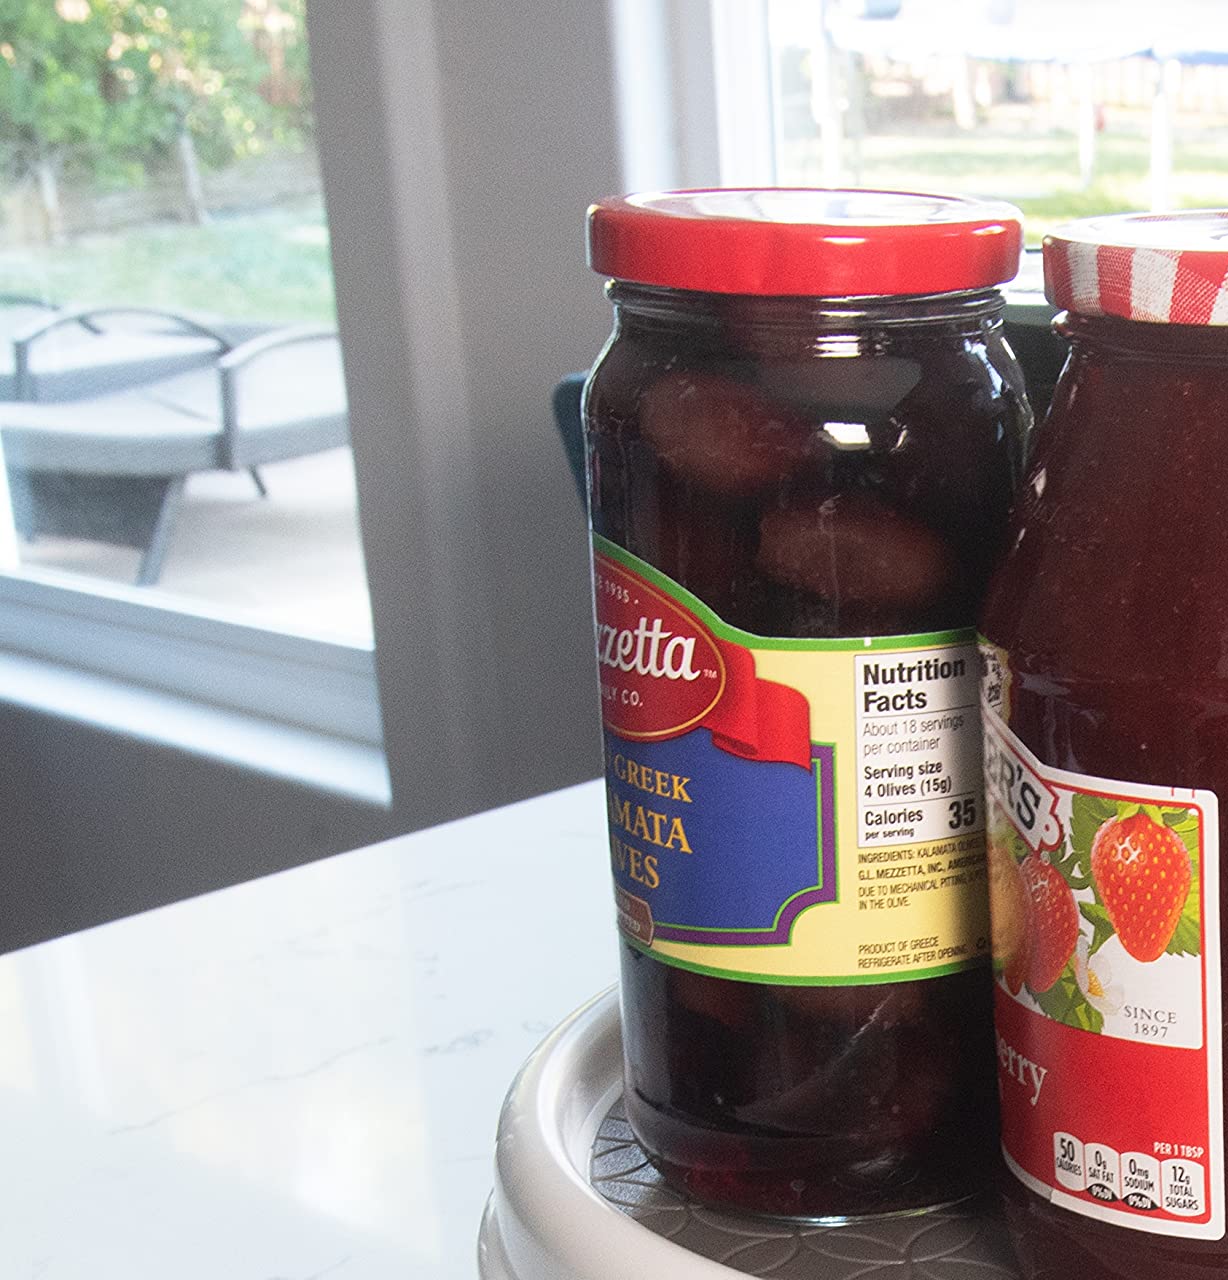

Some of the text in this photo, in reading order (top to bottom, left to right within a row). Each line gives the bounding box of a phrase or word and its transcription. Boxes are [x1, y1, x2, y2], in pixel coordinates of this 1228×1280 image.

[863, 658, 965, 685] Nutrition
[864, 689, 927, 713] Facts
[863, 714, 965, 737] About 18 servings
[864, 736, 941, 757] per container
[614, 753, 693, 803] GREEK
[864, 760, 943, 781] Serving size
[864, 775, 953, 798] 4 Olives (15g)
[864, 797, 977, 830] Calories 35
[865, 826, 915, 841] per serving
[858, 849, 915, 864] INGREDIENTS:
[858, 886, 876, 898] DUE
[877, 884, 888, 896] TO
[858, 899, 867, 910] IN
[870, 898, 885, 910] THE
[858, 936, 939, 955] PRODUCT OF GREECE
[858, 955, 911, 969] REFRIGERATE
[912, 951, 936, 963] AFTER
[1124, 1004, 1177, 1025] SINCE
[1133, 1022, 1169, 1039] 1897
[1060, 1137, 1076, 1162] 50
[1153, 1141, 1172, 1156] PER
[1180, 1144, 1205, 1158] TBSP
[1056, 1157, 1083, 1177] CALORIES
[1094, 1150, 1108, 1171] 0g
[1128, 1158, 1149, 1180] 0mg
[1088, 1166, 1115, 1184] SAT FAT
[1124, 1175, 1155, 1193] SODIUM
[1171, 1165, 1191, 1185] 12g
[1169, 1184, 1193, 1198] TOTAL
[1165, 1197, 1199, 1211] SUGARS
